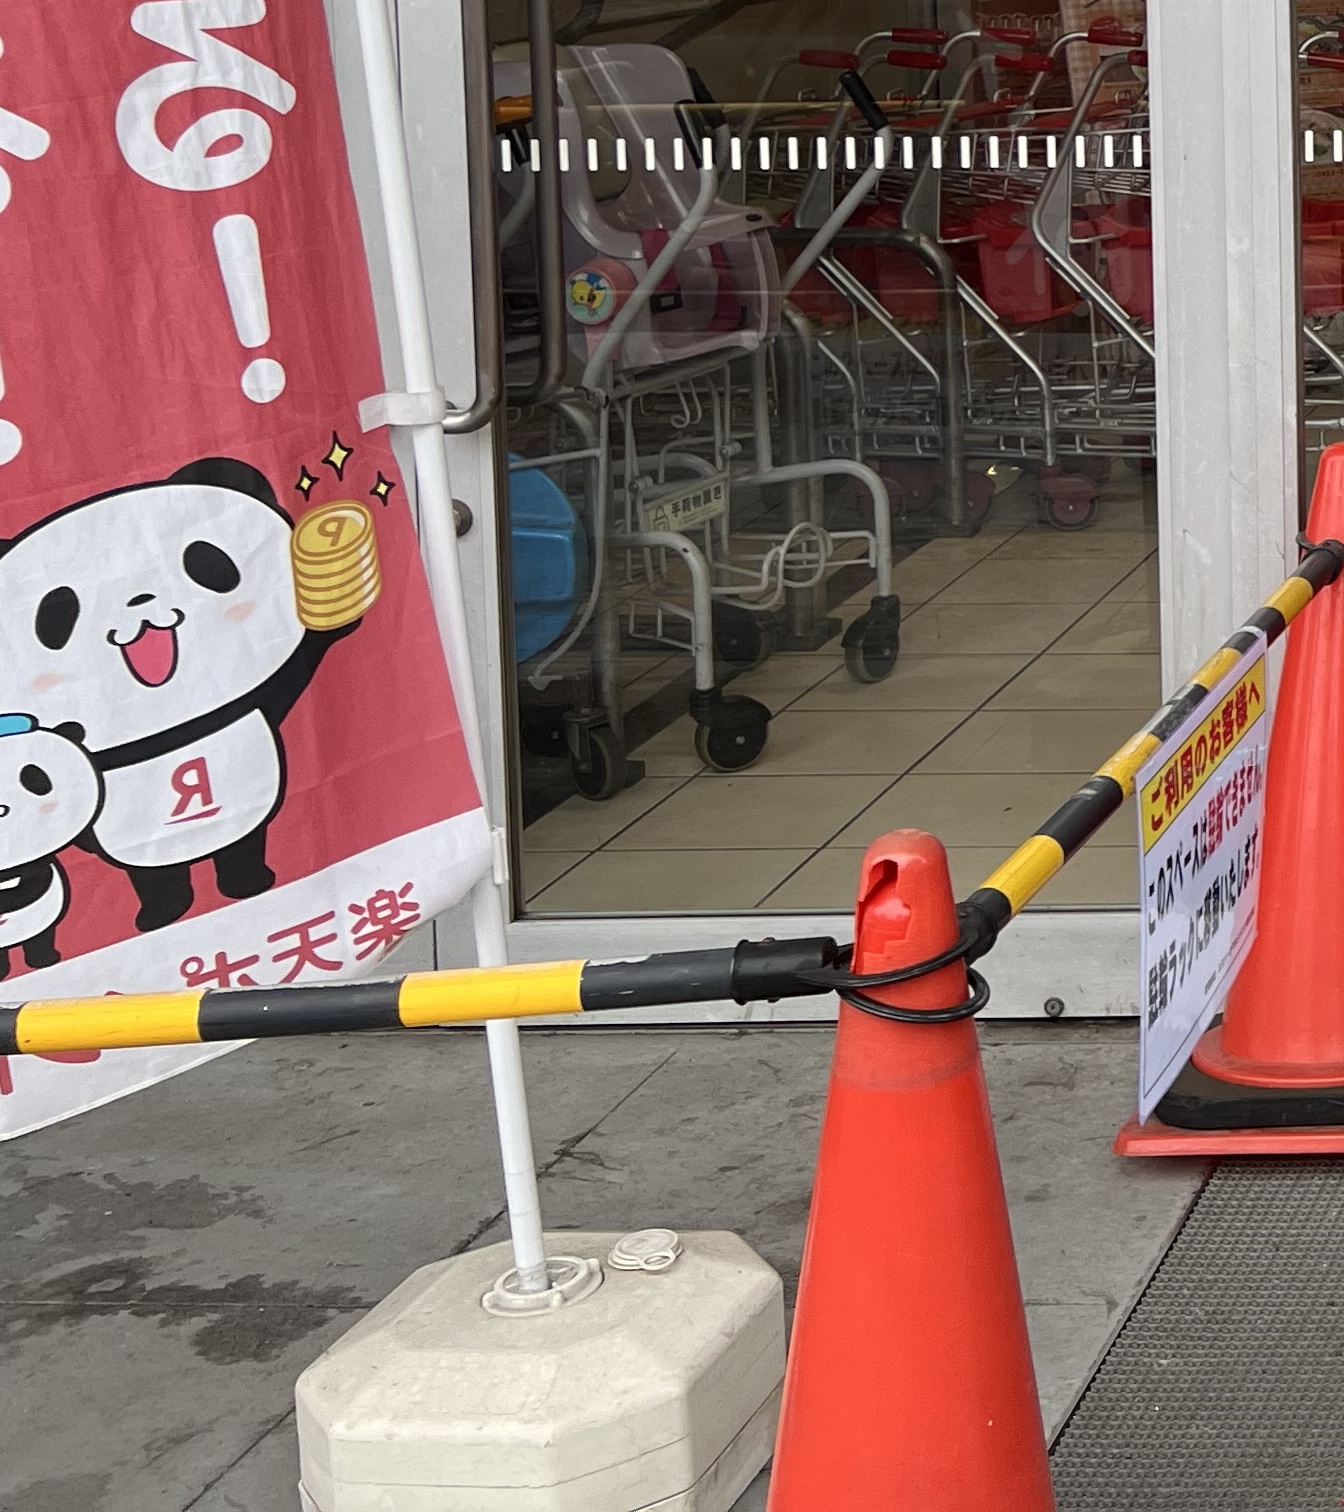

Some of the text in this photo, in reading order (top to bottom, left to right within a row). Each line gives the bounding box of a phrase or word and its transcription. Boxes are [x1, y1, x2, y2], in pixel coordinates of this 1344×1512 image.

[1152, 681, 1261, 832] ご利用のお客様へ
